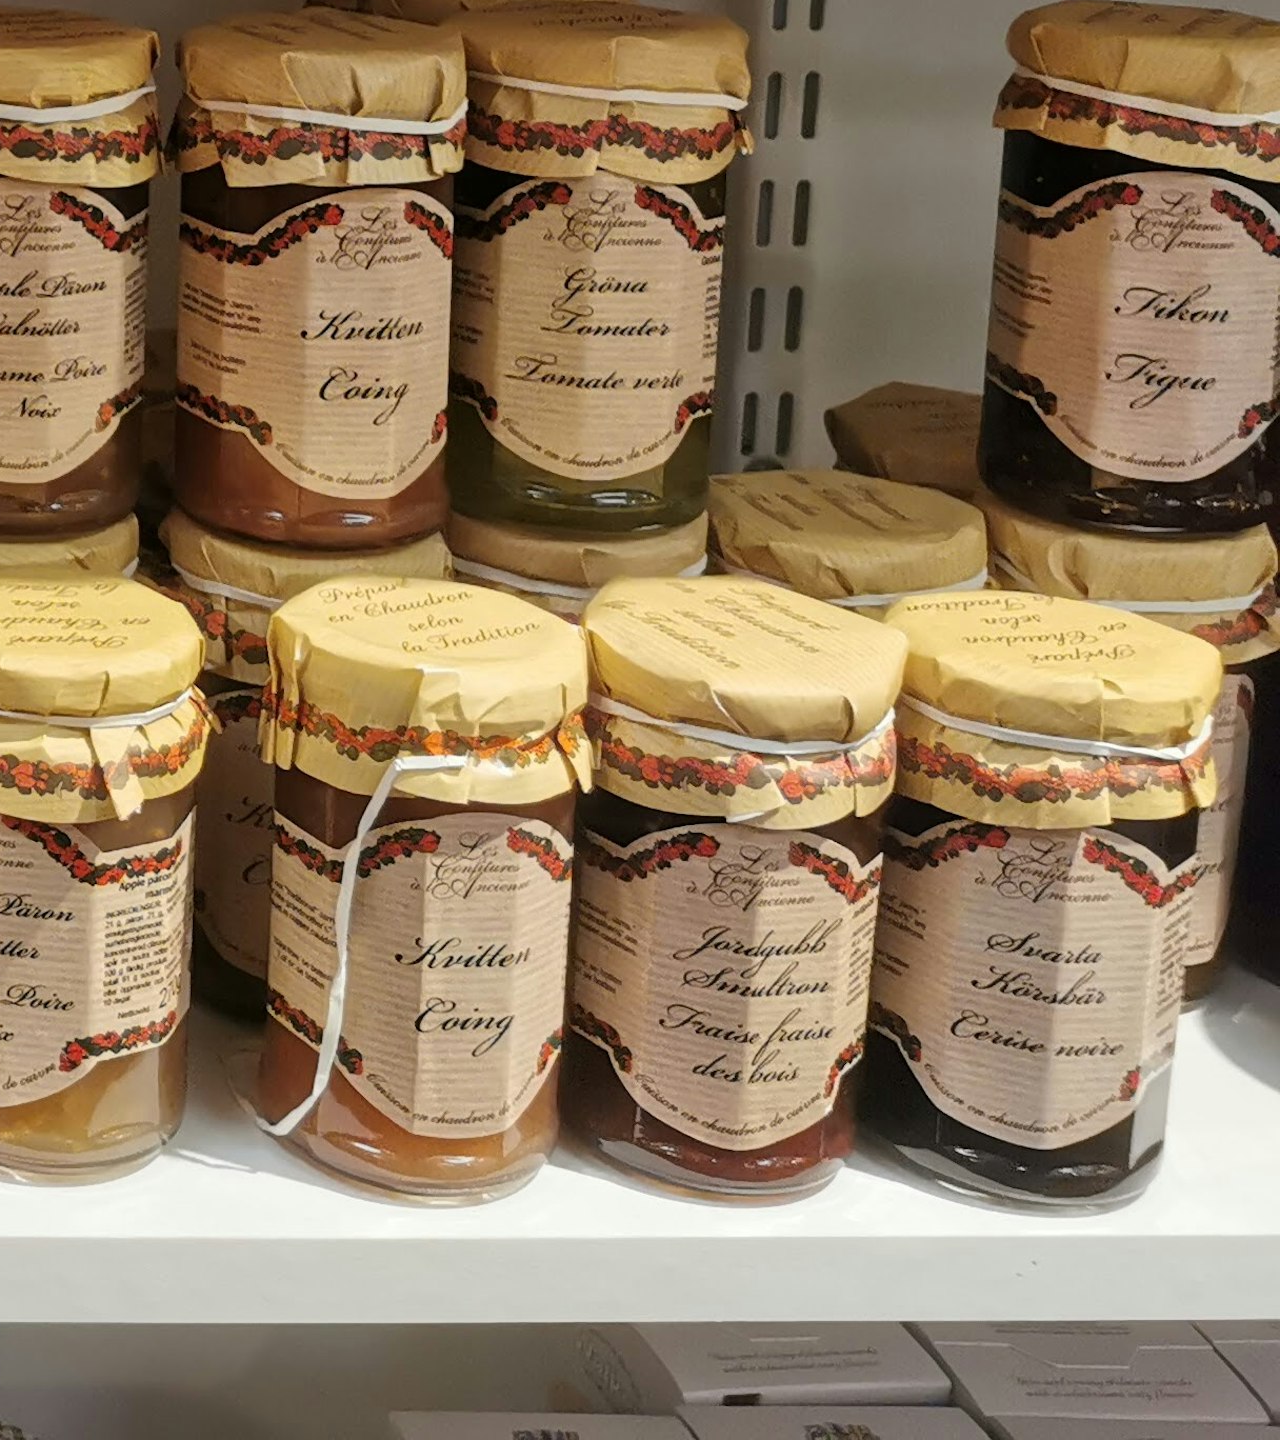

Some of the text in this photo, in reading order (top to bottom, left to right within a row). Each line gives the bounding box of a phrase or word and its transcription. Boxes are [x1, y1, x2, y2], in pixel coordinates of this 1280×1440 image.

[0, 984, 77, 1012] Poire
[414, 997, 516, 1057] Coing
[692, 1054, 745, 1084] des
